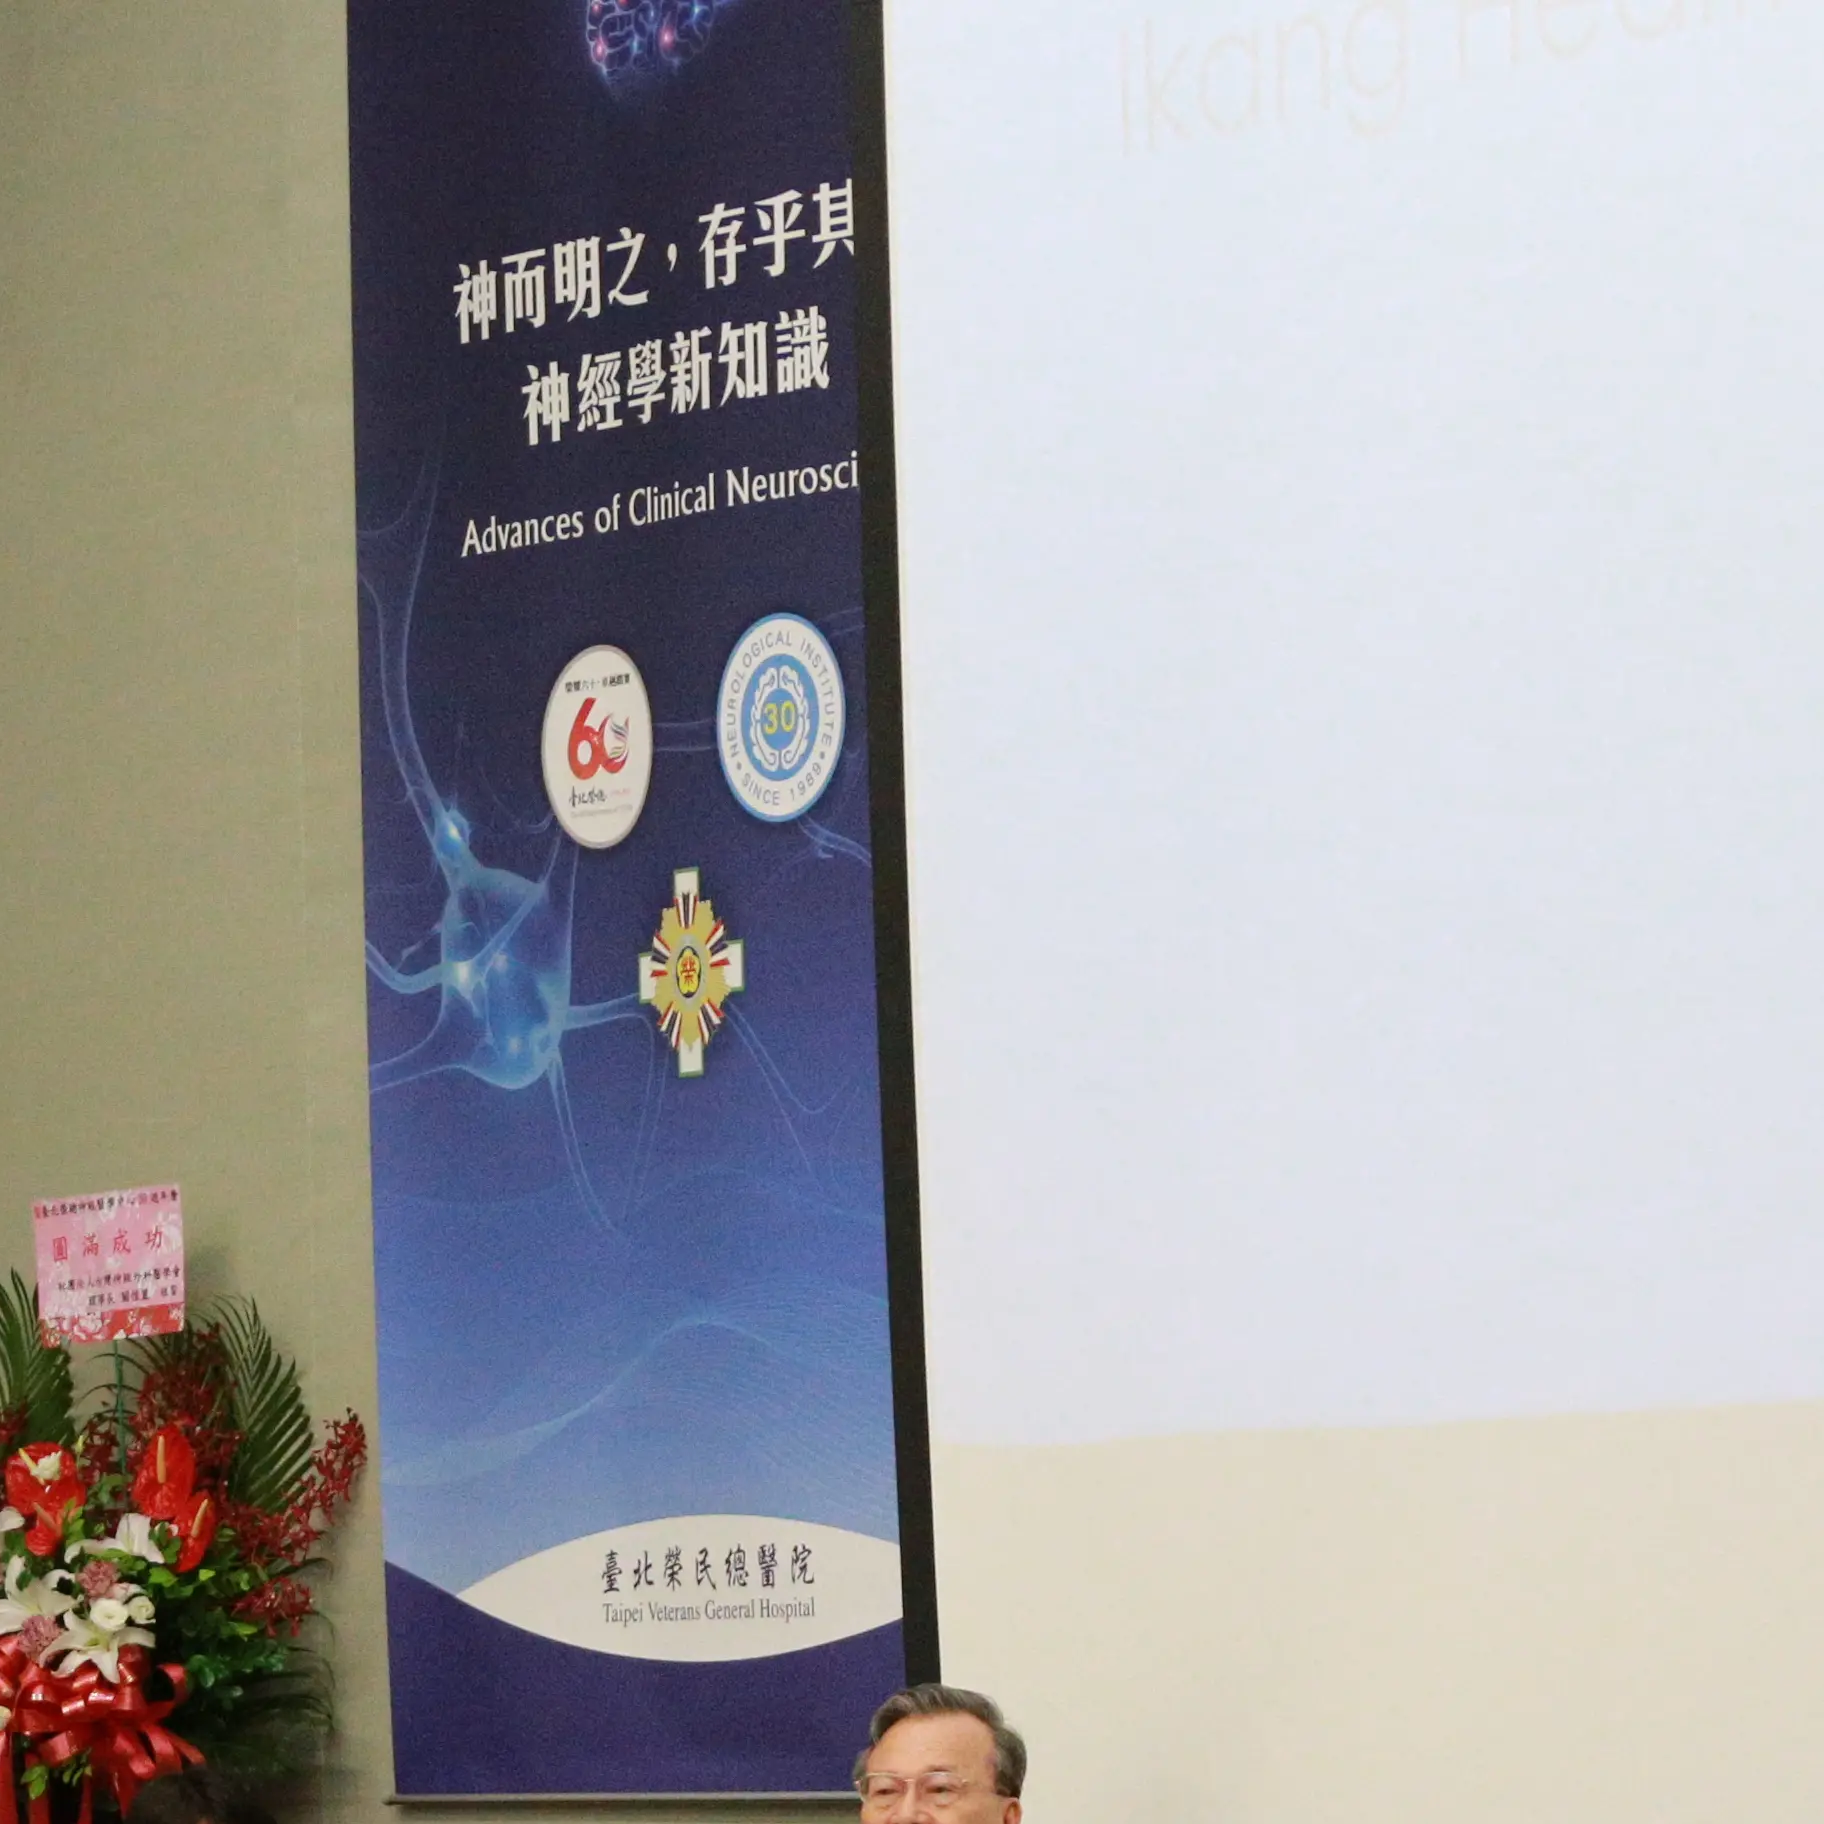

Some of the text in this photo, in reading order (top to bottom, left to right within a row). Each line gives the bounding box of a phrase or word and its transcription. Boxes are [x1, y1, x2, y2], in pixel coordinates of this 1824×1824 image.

[521, 305, 830, 447] 神經學新知識
[461, 450, 859, 557] Advances of Clinical Neurosci
[726, 630, 836, 758] NEUROLOGICAL INSTITUTE
[763, 700, 797, 735] 30
[741, 761, 823, 807] SINCE 1989
[53, 1226, 162, 1261] 圓滿成功
[601, 1543, 815, 1594] 臺北榮民總醫院
[602, 1596, 816, 1628] Taipei Veterans General Hospital
